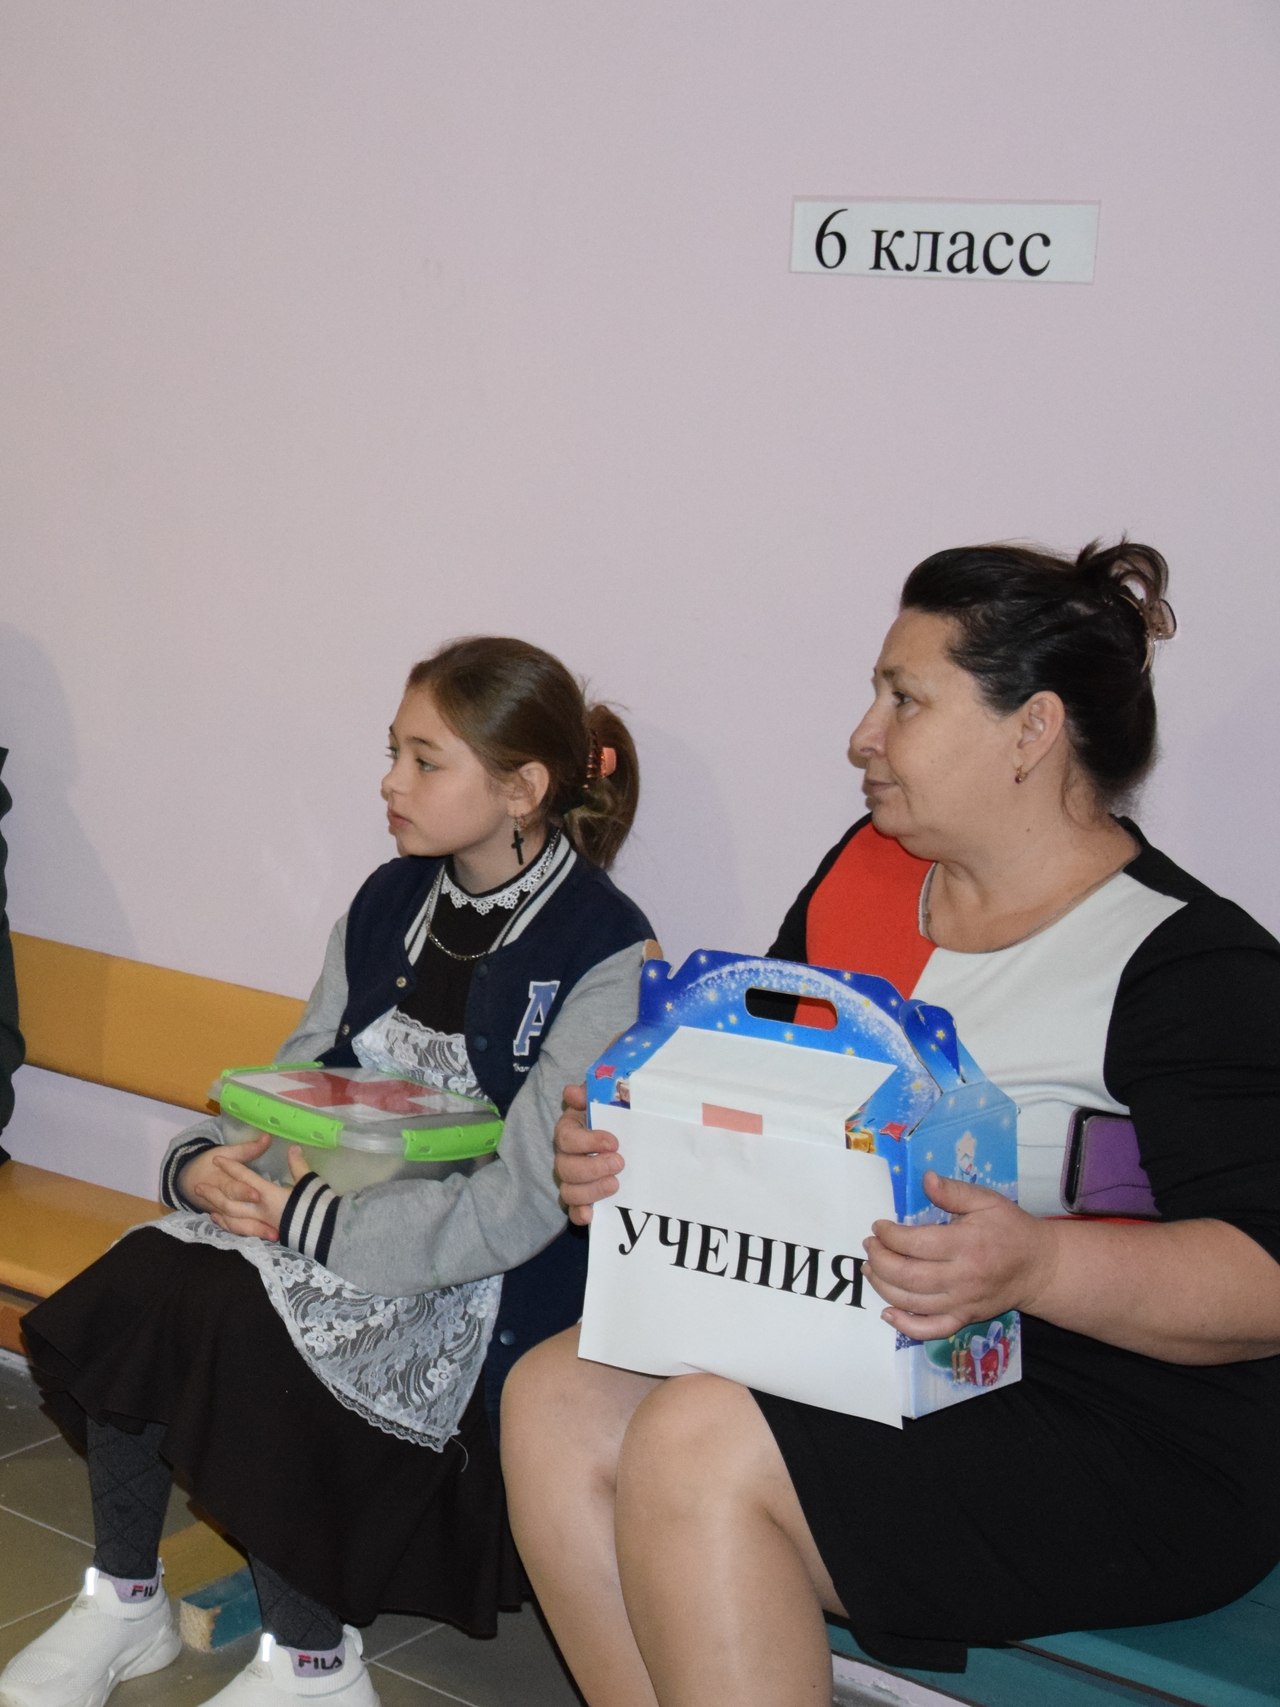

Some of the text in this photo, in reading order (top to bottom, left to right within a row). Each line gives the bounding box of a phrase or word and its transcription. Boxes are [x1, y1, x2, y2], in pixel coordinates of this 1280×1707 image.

[815, 208, 1051, 277] 6 класс
[513, 981, 560, 1056] A
[615, 1205, 868, 1310] УЧЕНИЯ
[298, 1654, 343, 1670] FILA
